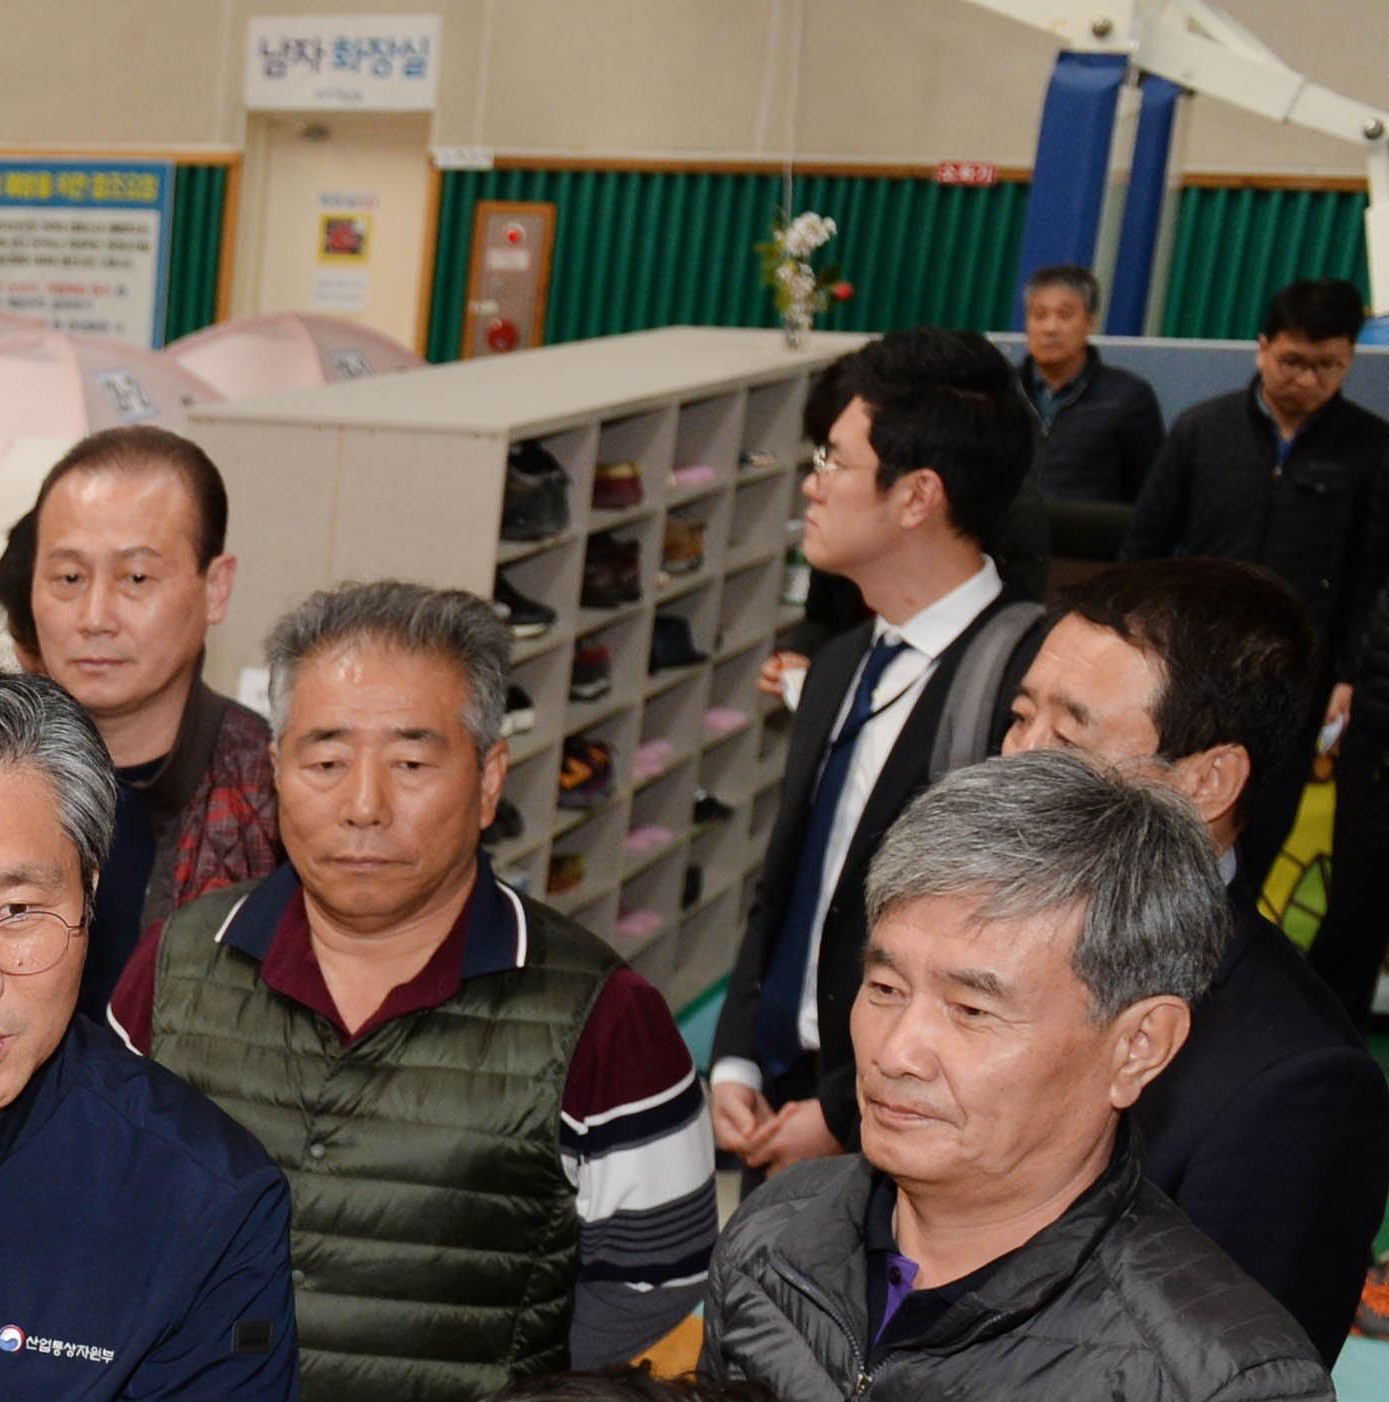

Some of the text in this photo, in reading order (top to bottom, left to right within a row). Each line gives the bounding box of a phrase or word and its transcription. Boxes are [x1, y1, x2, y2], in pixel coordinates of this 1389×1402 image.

[258, 35, 431, 79] 남자 화장실
[25, 1335, 116, 1364] 산업통상자원부
